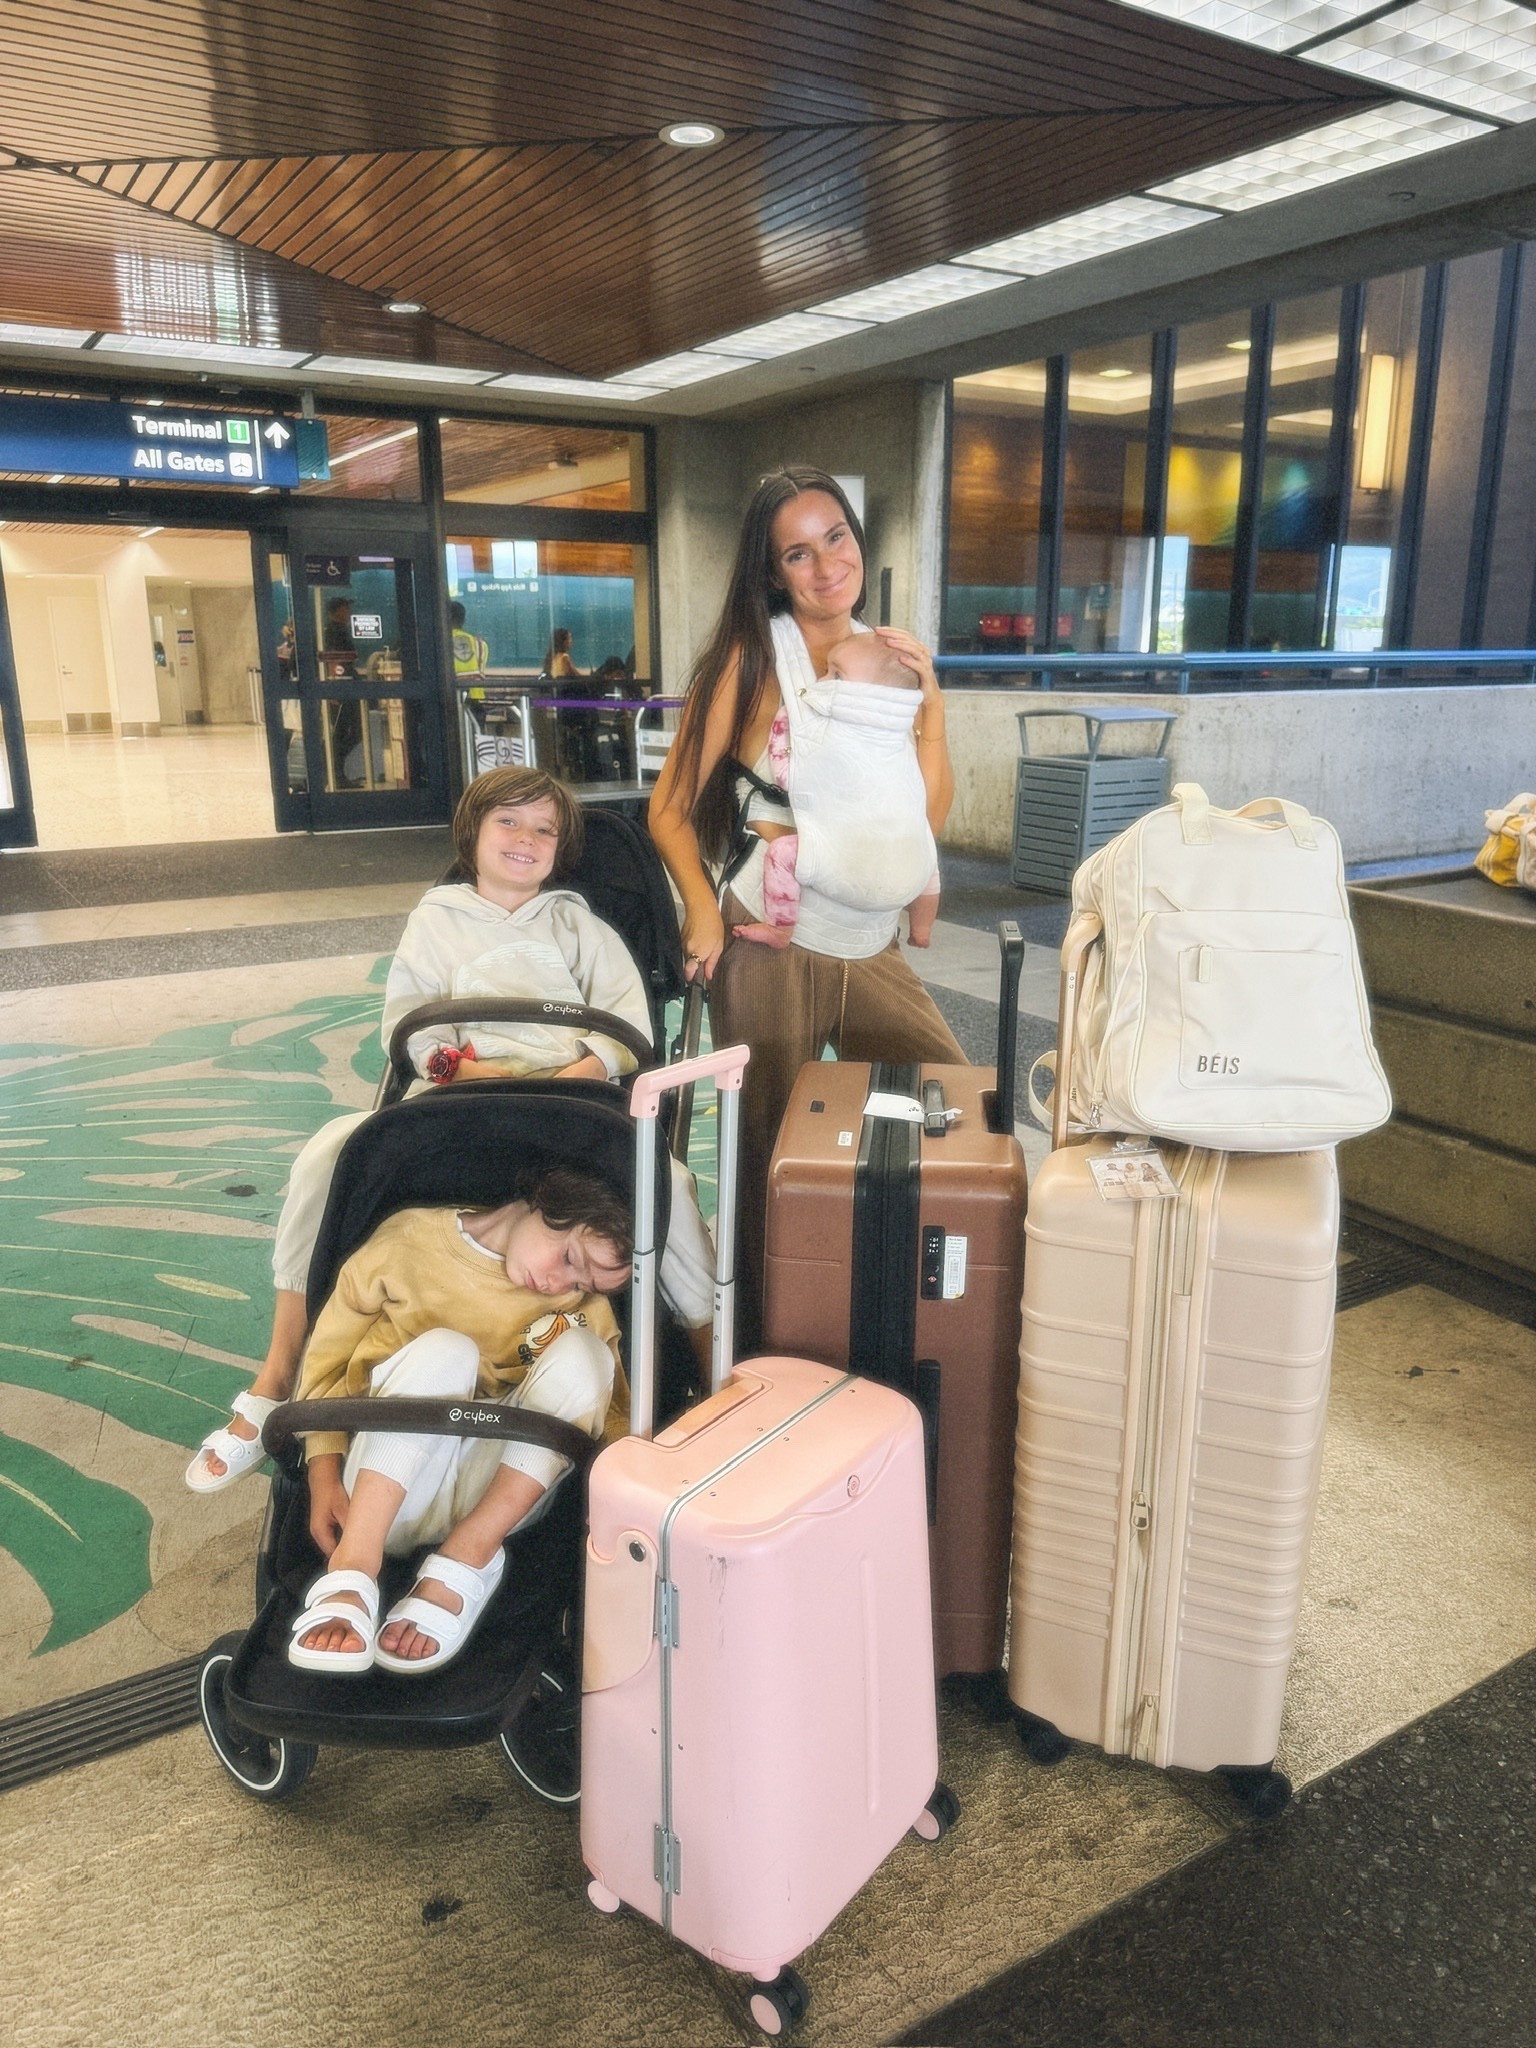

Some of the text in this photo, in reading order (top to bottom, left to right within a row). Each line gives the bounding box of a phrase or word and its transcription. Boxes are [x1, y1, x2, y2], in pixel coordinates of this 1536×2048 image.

[131, 415, 222, 440] Terminal
[134, 449, 225, 473] All Gates
[554, 1005, 583, 1015] cybex
[463, 1409, 501, 1425] cybex
